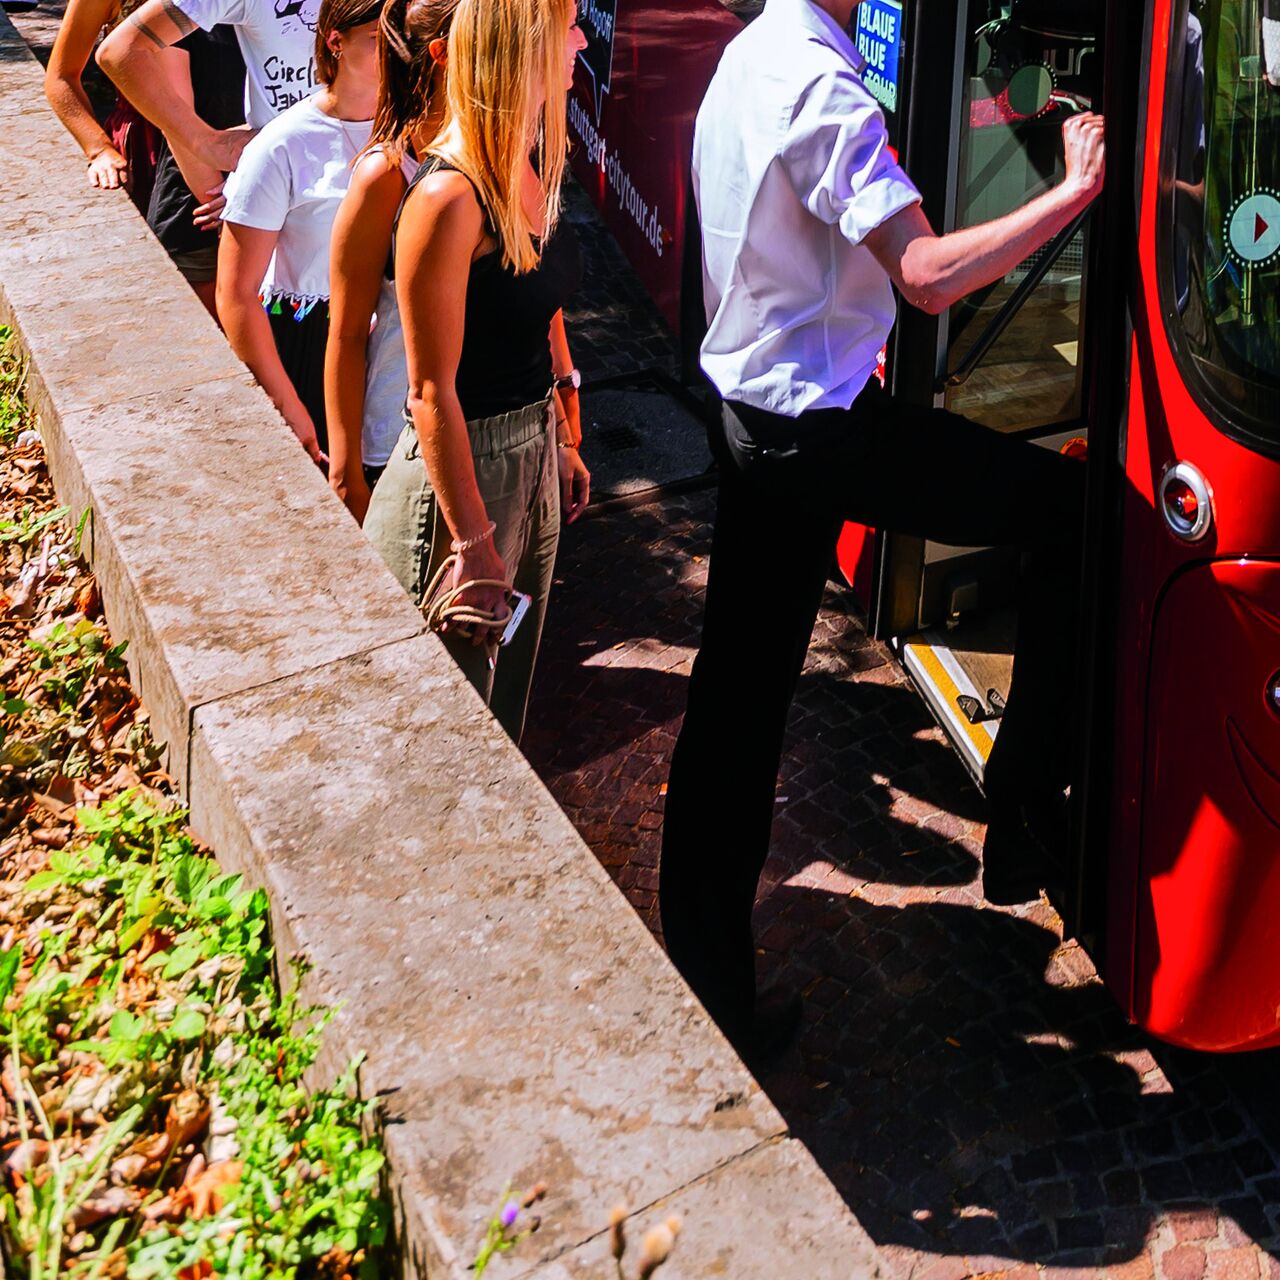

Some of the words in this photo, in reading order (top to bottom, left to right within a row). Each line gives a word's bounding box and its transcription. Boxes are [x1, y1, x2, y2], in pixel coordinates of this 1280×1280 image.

[860, 1, 896, 44] BLAUE
[858, 32, 887, 72] BLUE
[568, 96, 663, 257] .stuttgart-citytour.de
